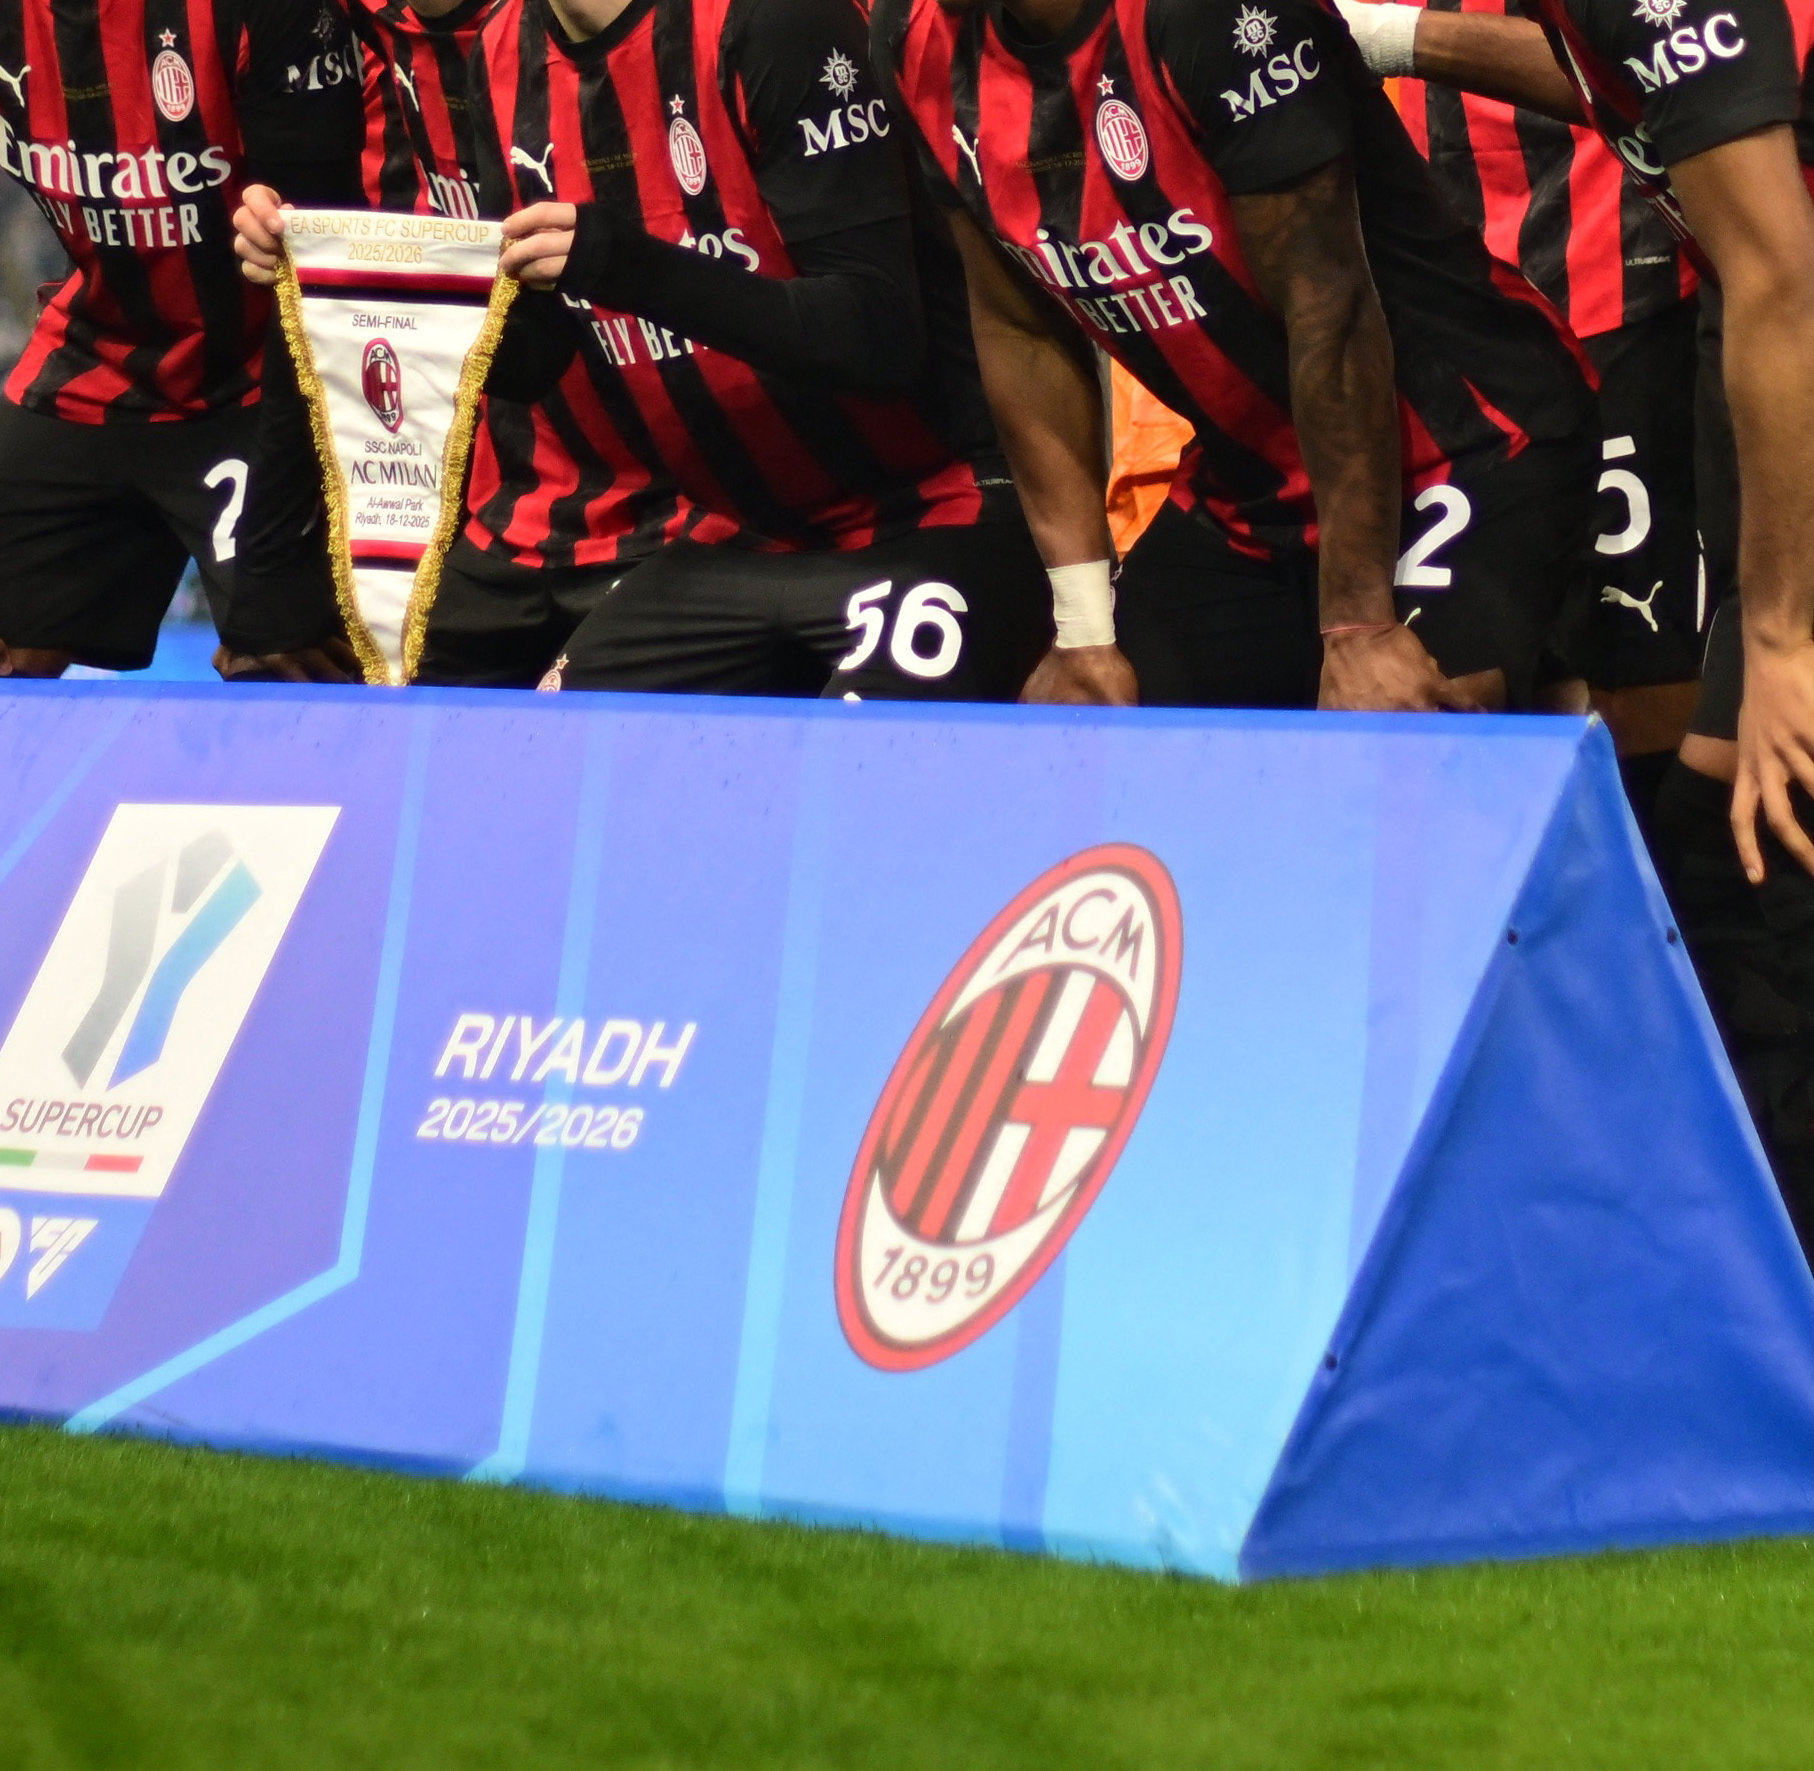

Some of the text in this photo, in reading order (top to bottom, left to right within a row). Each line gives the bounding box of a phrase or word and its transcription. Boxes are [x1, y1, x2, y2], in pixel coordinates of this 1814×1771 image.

[1623, 12, 1744, 94] MSC
[1220, 37, 1320, 123] MSC
[798, 98, 890, 157] MSC
[1104, 106, 1129, 121] ACM
[1120, 158, 1142, 171] 1899
[82, 203, 202, 248] BETTER
[290, 216, 490, 243] EA SPORTS FC SUPERCUP
[347, 243, 423, 264] 2025/2026
[352, 313, 418, 330] SEMI-FINAL
[1078, 275, 1208, 334] BETTER
[591, 318, 636, 366] FLY
[365, 441, 422, 456] SSC NAPOLI
[351, 460, 437, 489] AC MILAN
[367, 496, 424, 511] Al-Awwal Park
[386, 513, 430, 528] 18-12-2025
[1394, 484, 1471, 587] 2
[838, 580, 968, 678] 56
[992, 887, 1144, 984] ACM
[434, 1013, 697, 1088] RIYADH
[416, 1097, 644, 1149] 2025/2026
[873, 1245, 996, 1305] 1899
